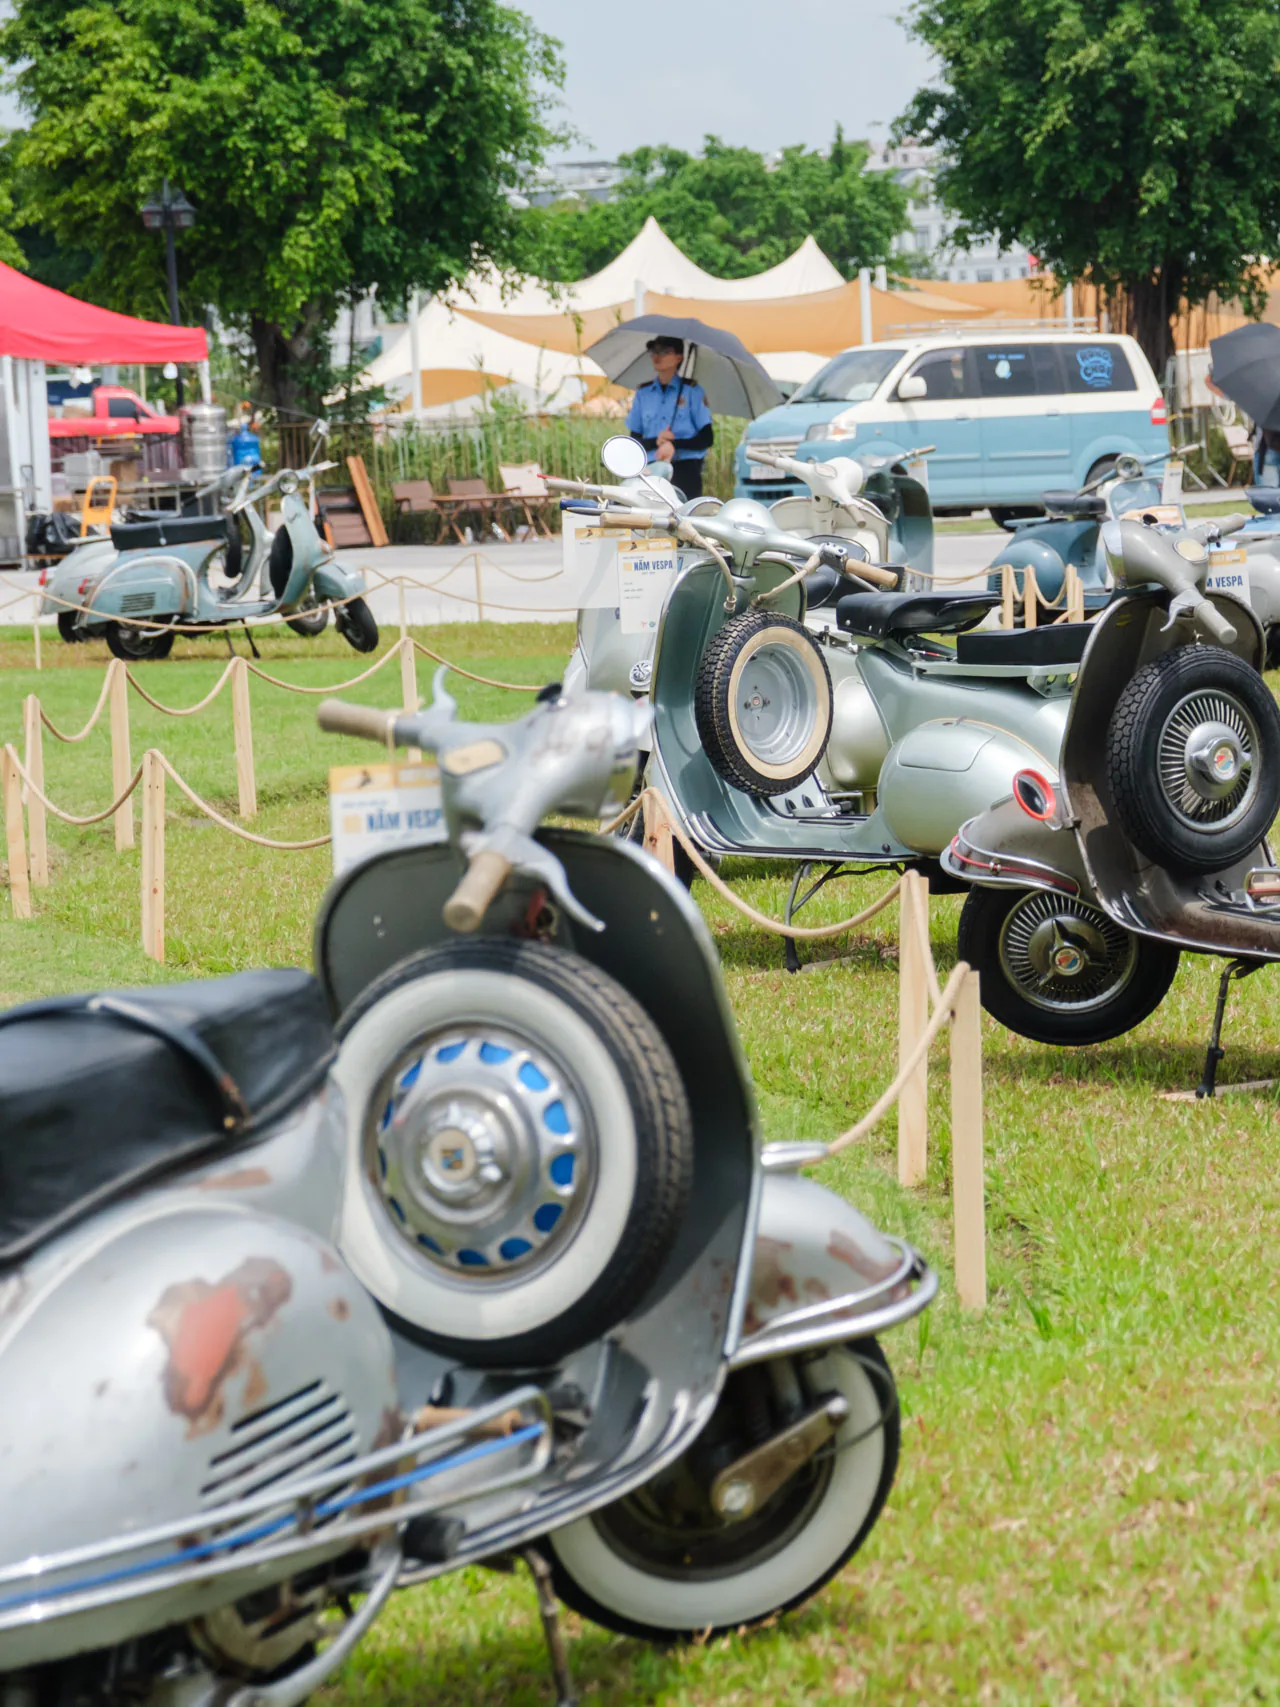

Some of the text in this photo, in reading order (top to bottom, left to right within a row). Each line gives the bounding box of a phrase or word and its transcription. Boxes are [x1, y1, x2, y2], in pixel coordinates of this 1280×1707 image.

[652, 559, 673, 571] VESPA
[1215, 575, 1243, 588] VESPA
[407, 808, 442, 830] VESP
